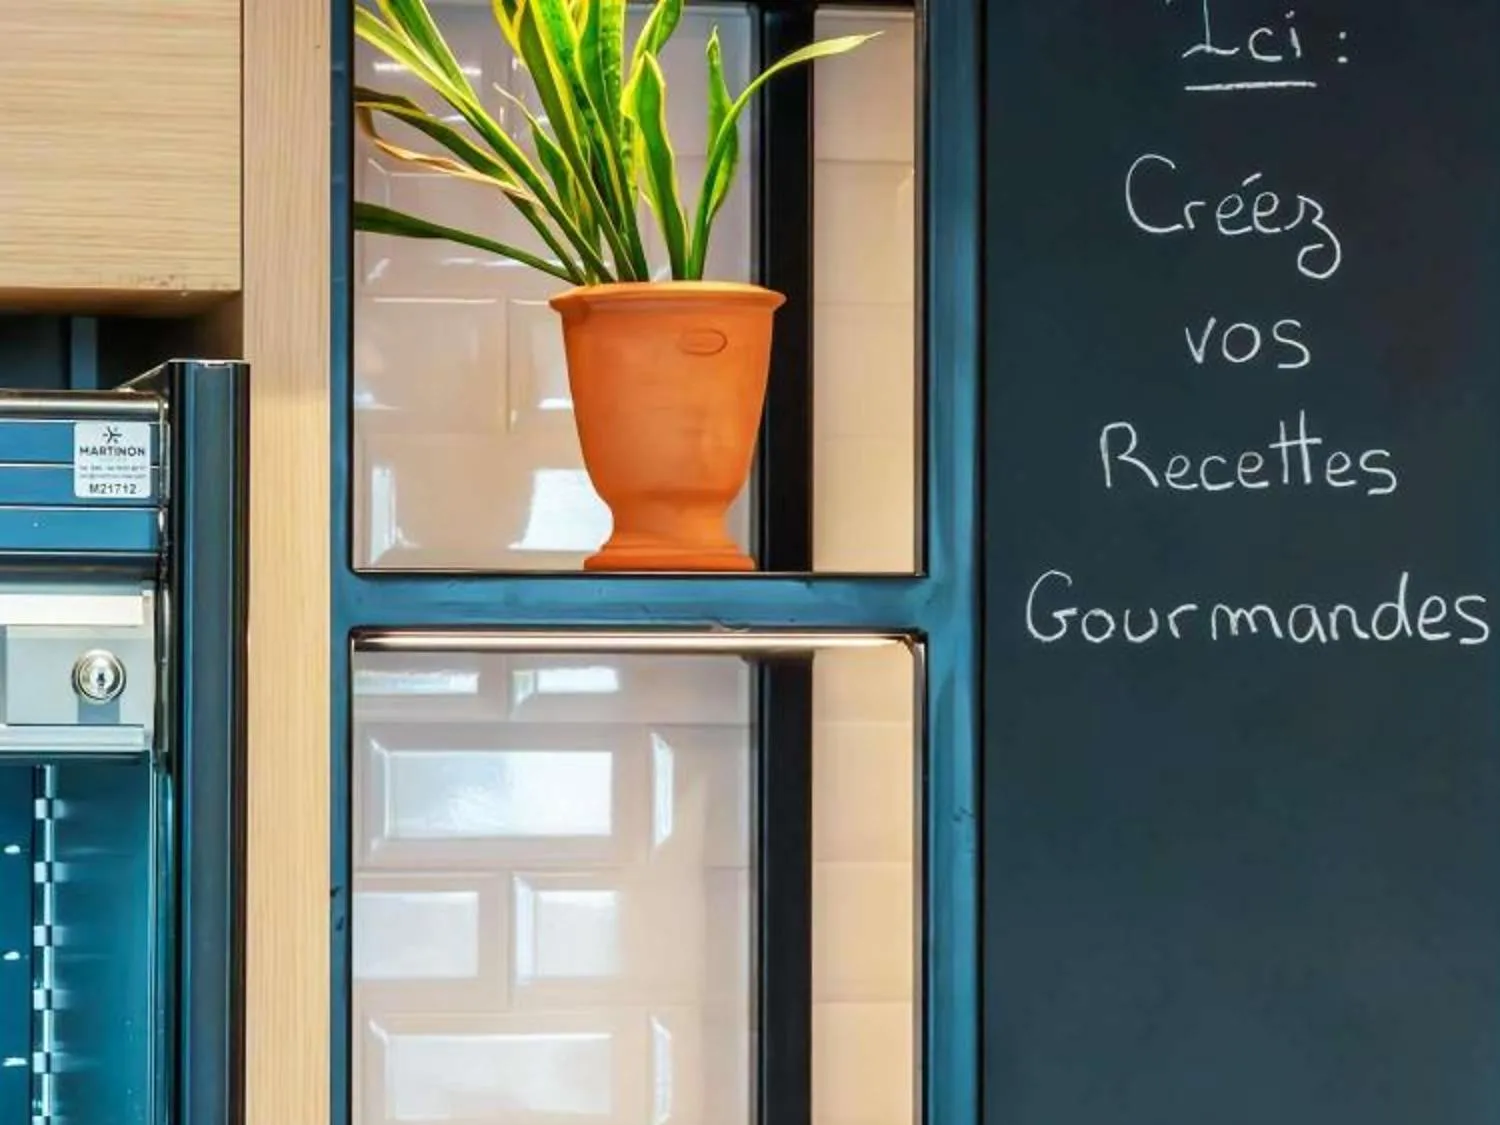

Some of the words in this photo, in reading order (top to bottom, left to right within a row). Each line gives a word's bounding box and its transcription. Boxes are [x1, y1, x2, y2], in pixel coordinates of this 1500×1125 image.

[1125, 153, 1342, 280] Créez
[1185, 316, 1311, 369] vos
[79, 445, 146, 458] MARTINON
[1099, 409, 1398, 496] Recettes
[89, 482, 137, 495] M21712
[1025, 569, 1490, 645] Gourmandes
